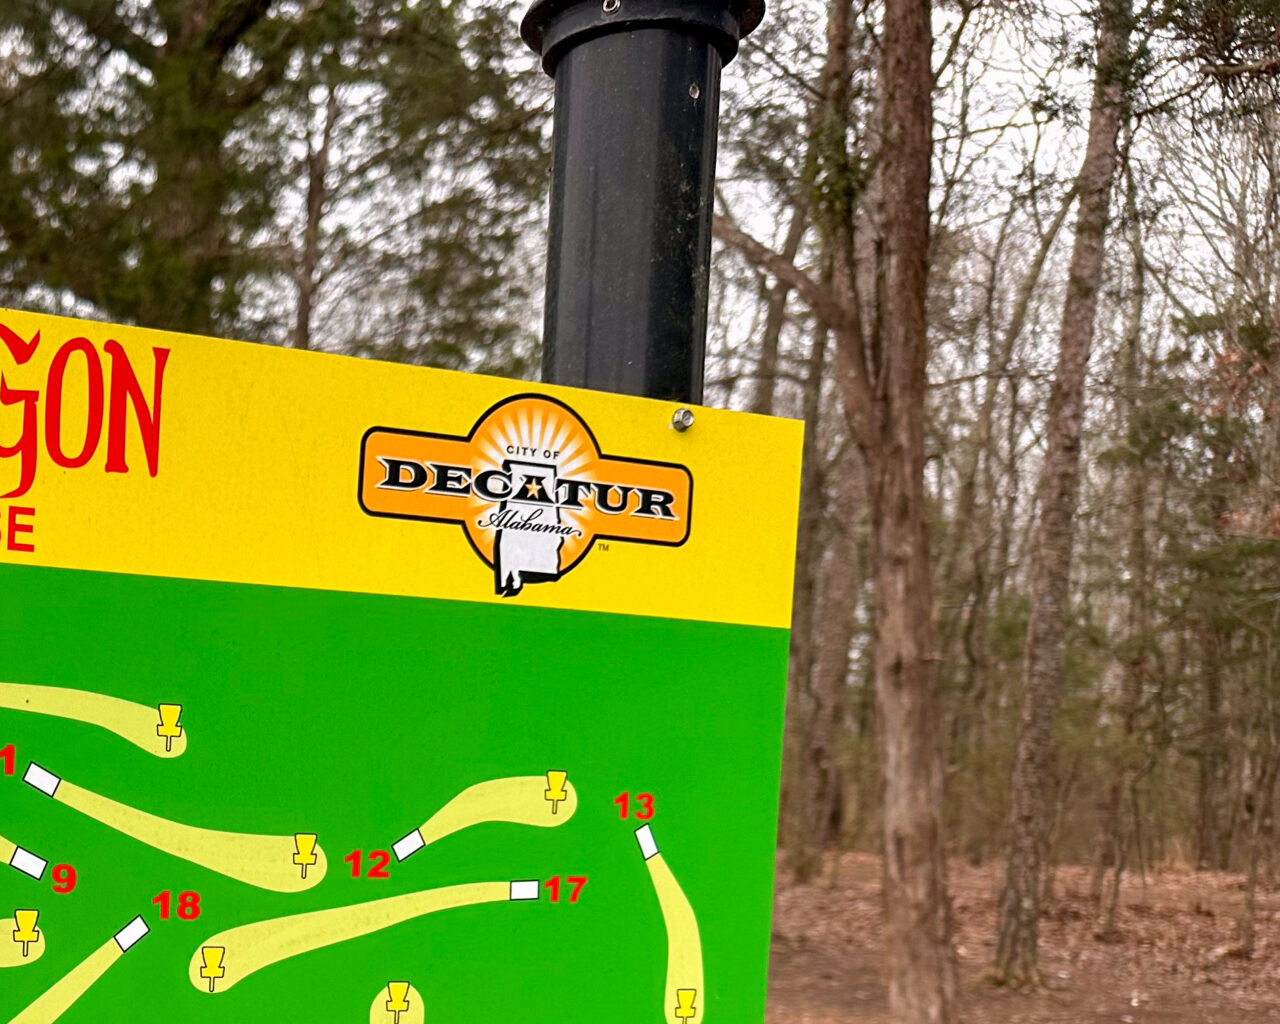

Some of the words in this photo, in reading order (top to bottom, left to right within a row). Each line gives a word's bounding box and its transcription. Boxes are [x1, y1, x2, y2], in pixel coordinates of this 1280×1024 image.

[505, 445, 538, 459] CITY
[543, 449, 561, 460] OF
[376, 456, 678, 520] DECATUR
[478, 508, 582, 537] Alabama
[613, 793, 655, 820] 13
[344, 850, 391, 878] 12
[52, 864, 78, 894] 9
[545, 876, 588, 903] 17
[152, 891, 201, 920] 18
